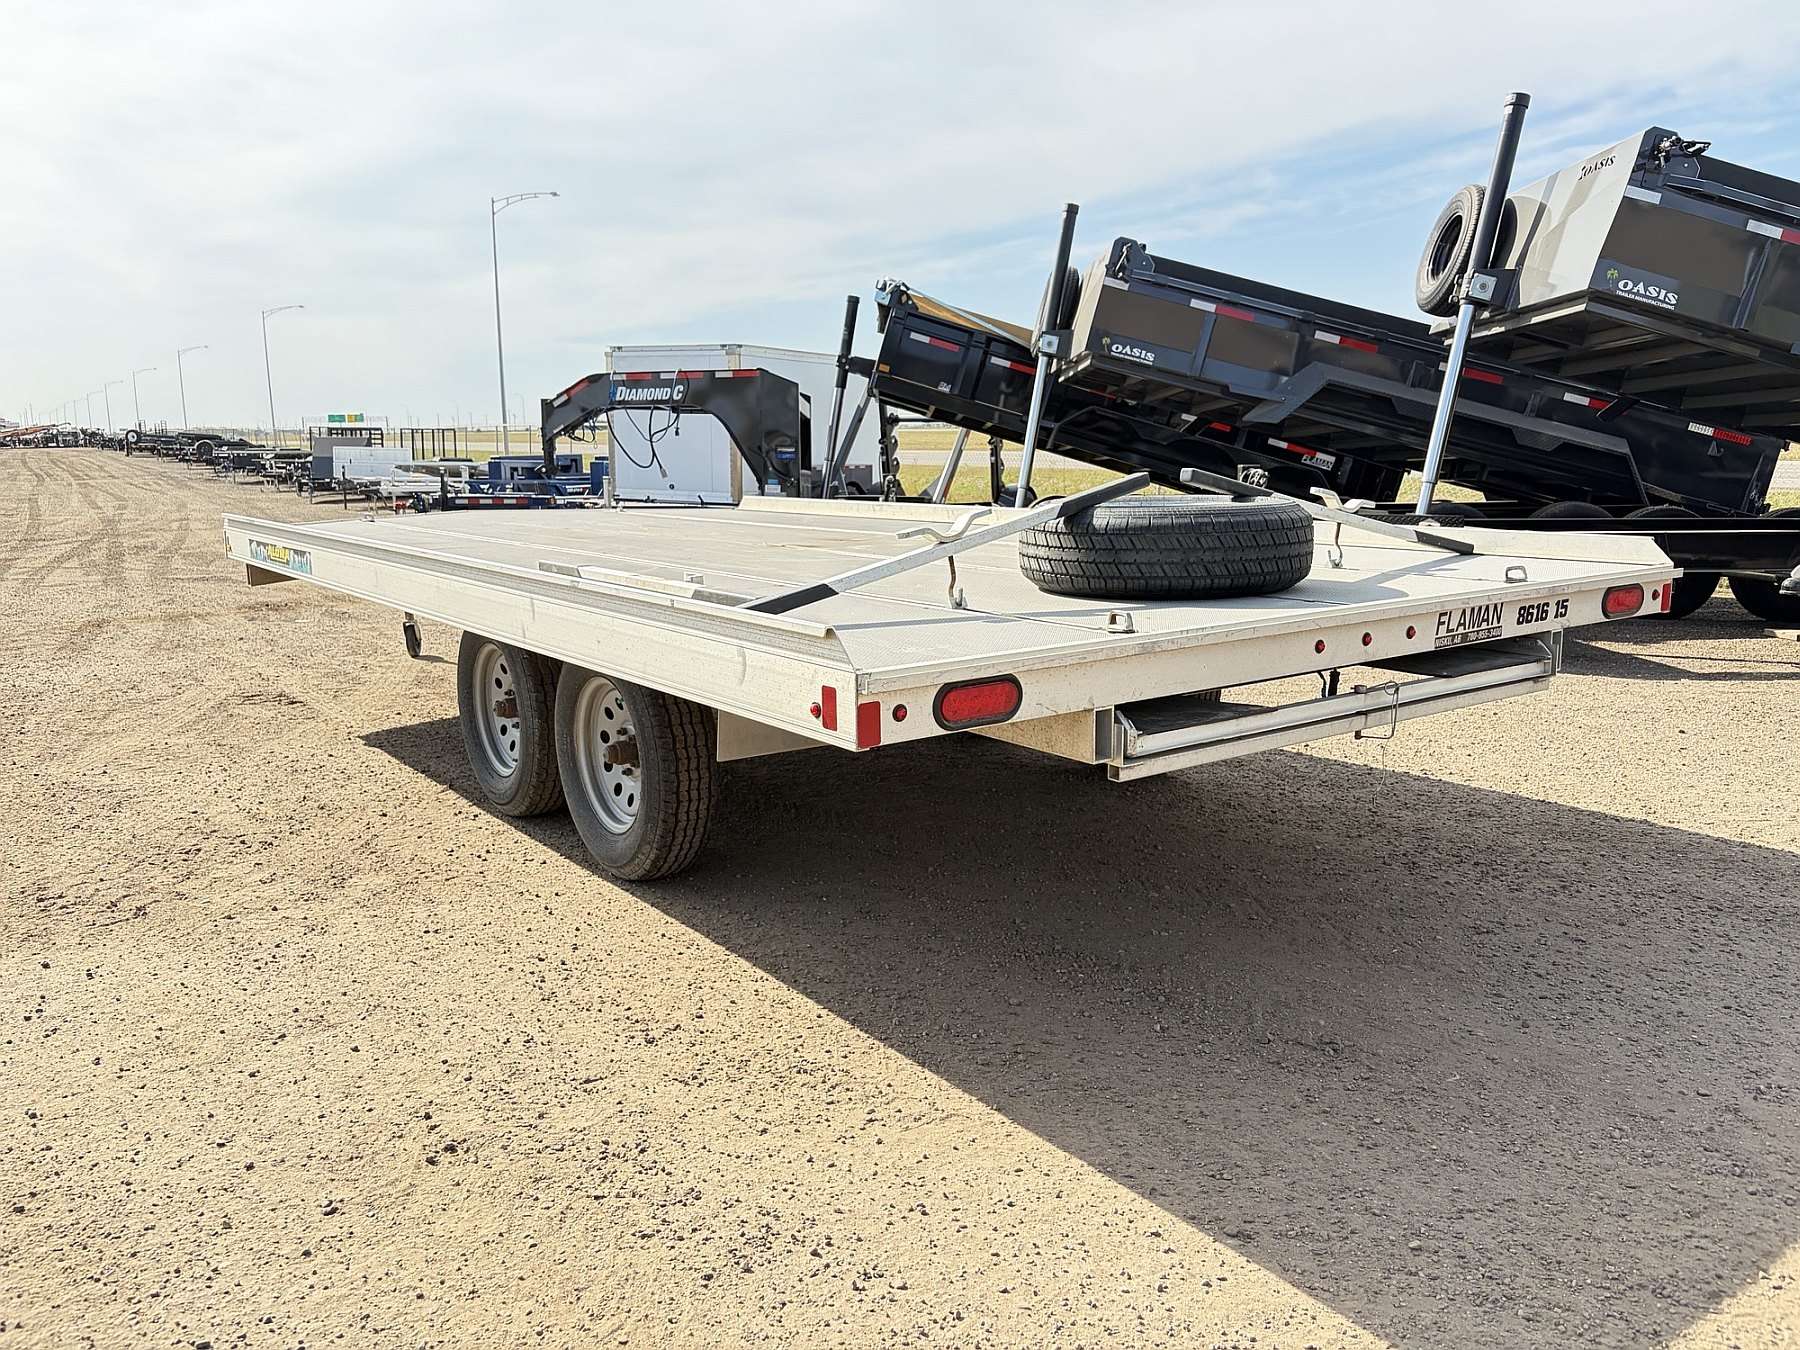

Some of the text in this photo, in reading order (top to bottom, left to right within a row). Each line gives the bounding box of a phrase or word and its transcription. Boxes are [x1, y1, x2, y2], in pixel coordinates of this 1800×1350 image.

[1616, 290, 1675, 311] TRAILER MANUFACTURING
[1618, 279, 1678, 305] OASIS
[1111, 344, 1155, 361] OASIS
[615, 384, 684, 401] DIAMOND C
[1435, 599, 1570, 635] FLAMAN 8616 15
